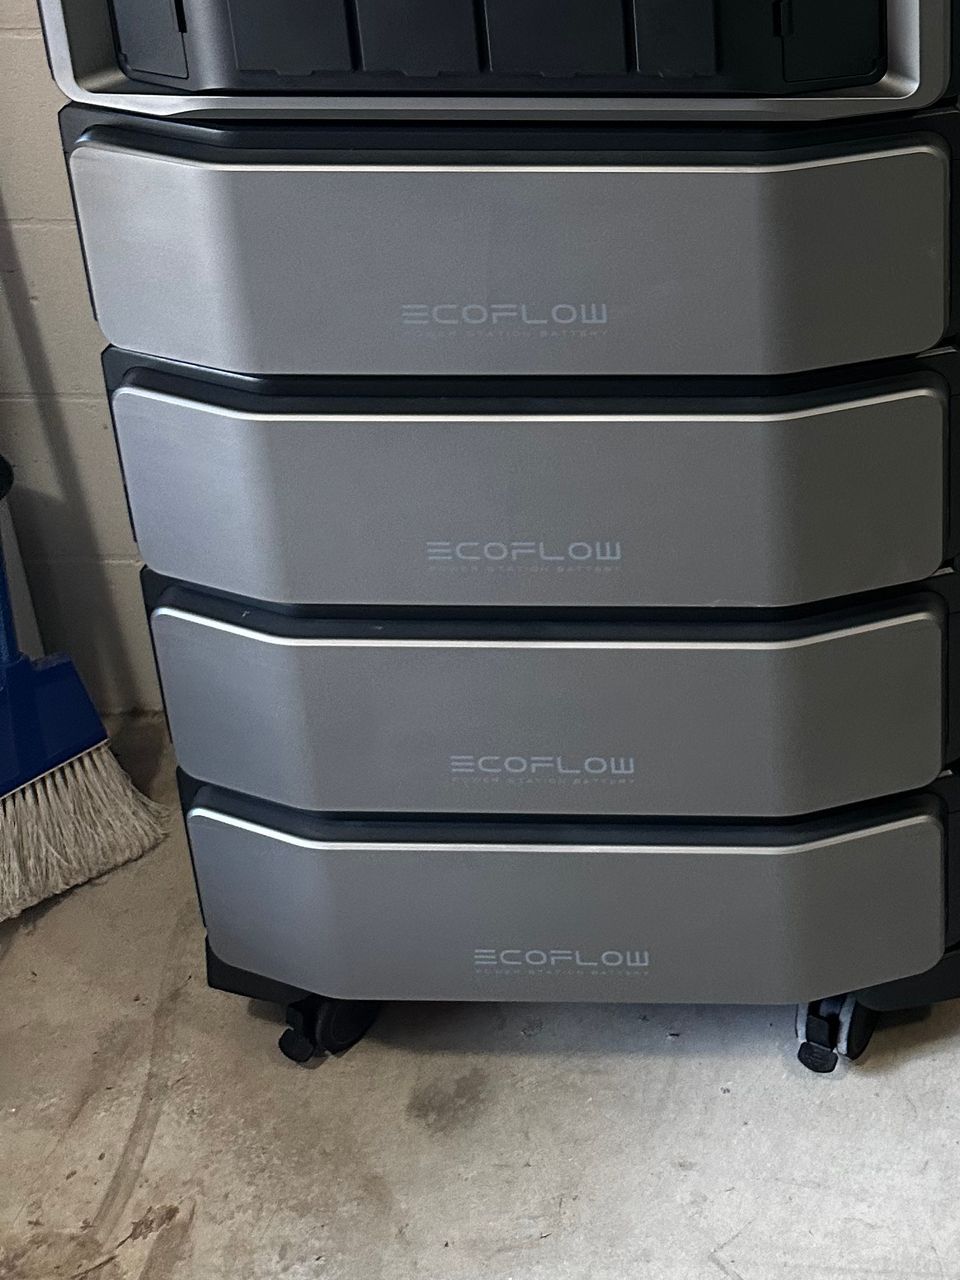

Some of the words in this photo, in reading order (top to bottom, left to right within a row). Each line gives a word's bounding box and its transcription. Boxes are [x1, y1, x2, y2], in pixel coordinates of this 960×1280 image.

[401, 304, 608, 324] ECOFLOW
[425, 542, 621, 561] ECOFLOW
[449, 755, 635, 774] ECOFLOW
[473, 949, 650, 967] ECOFLOW
